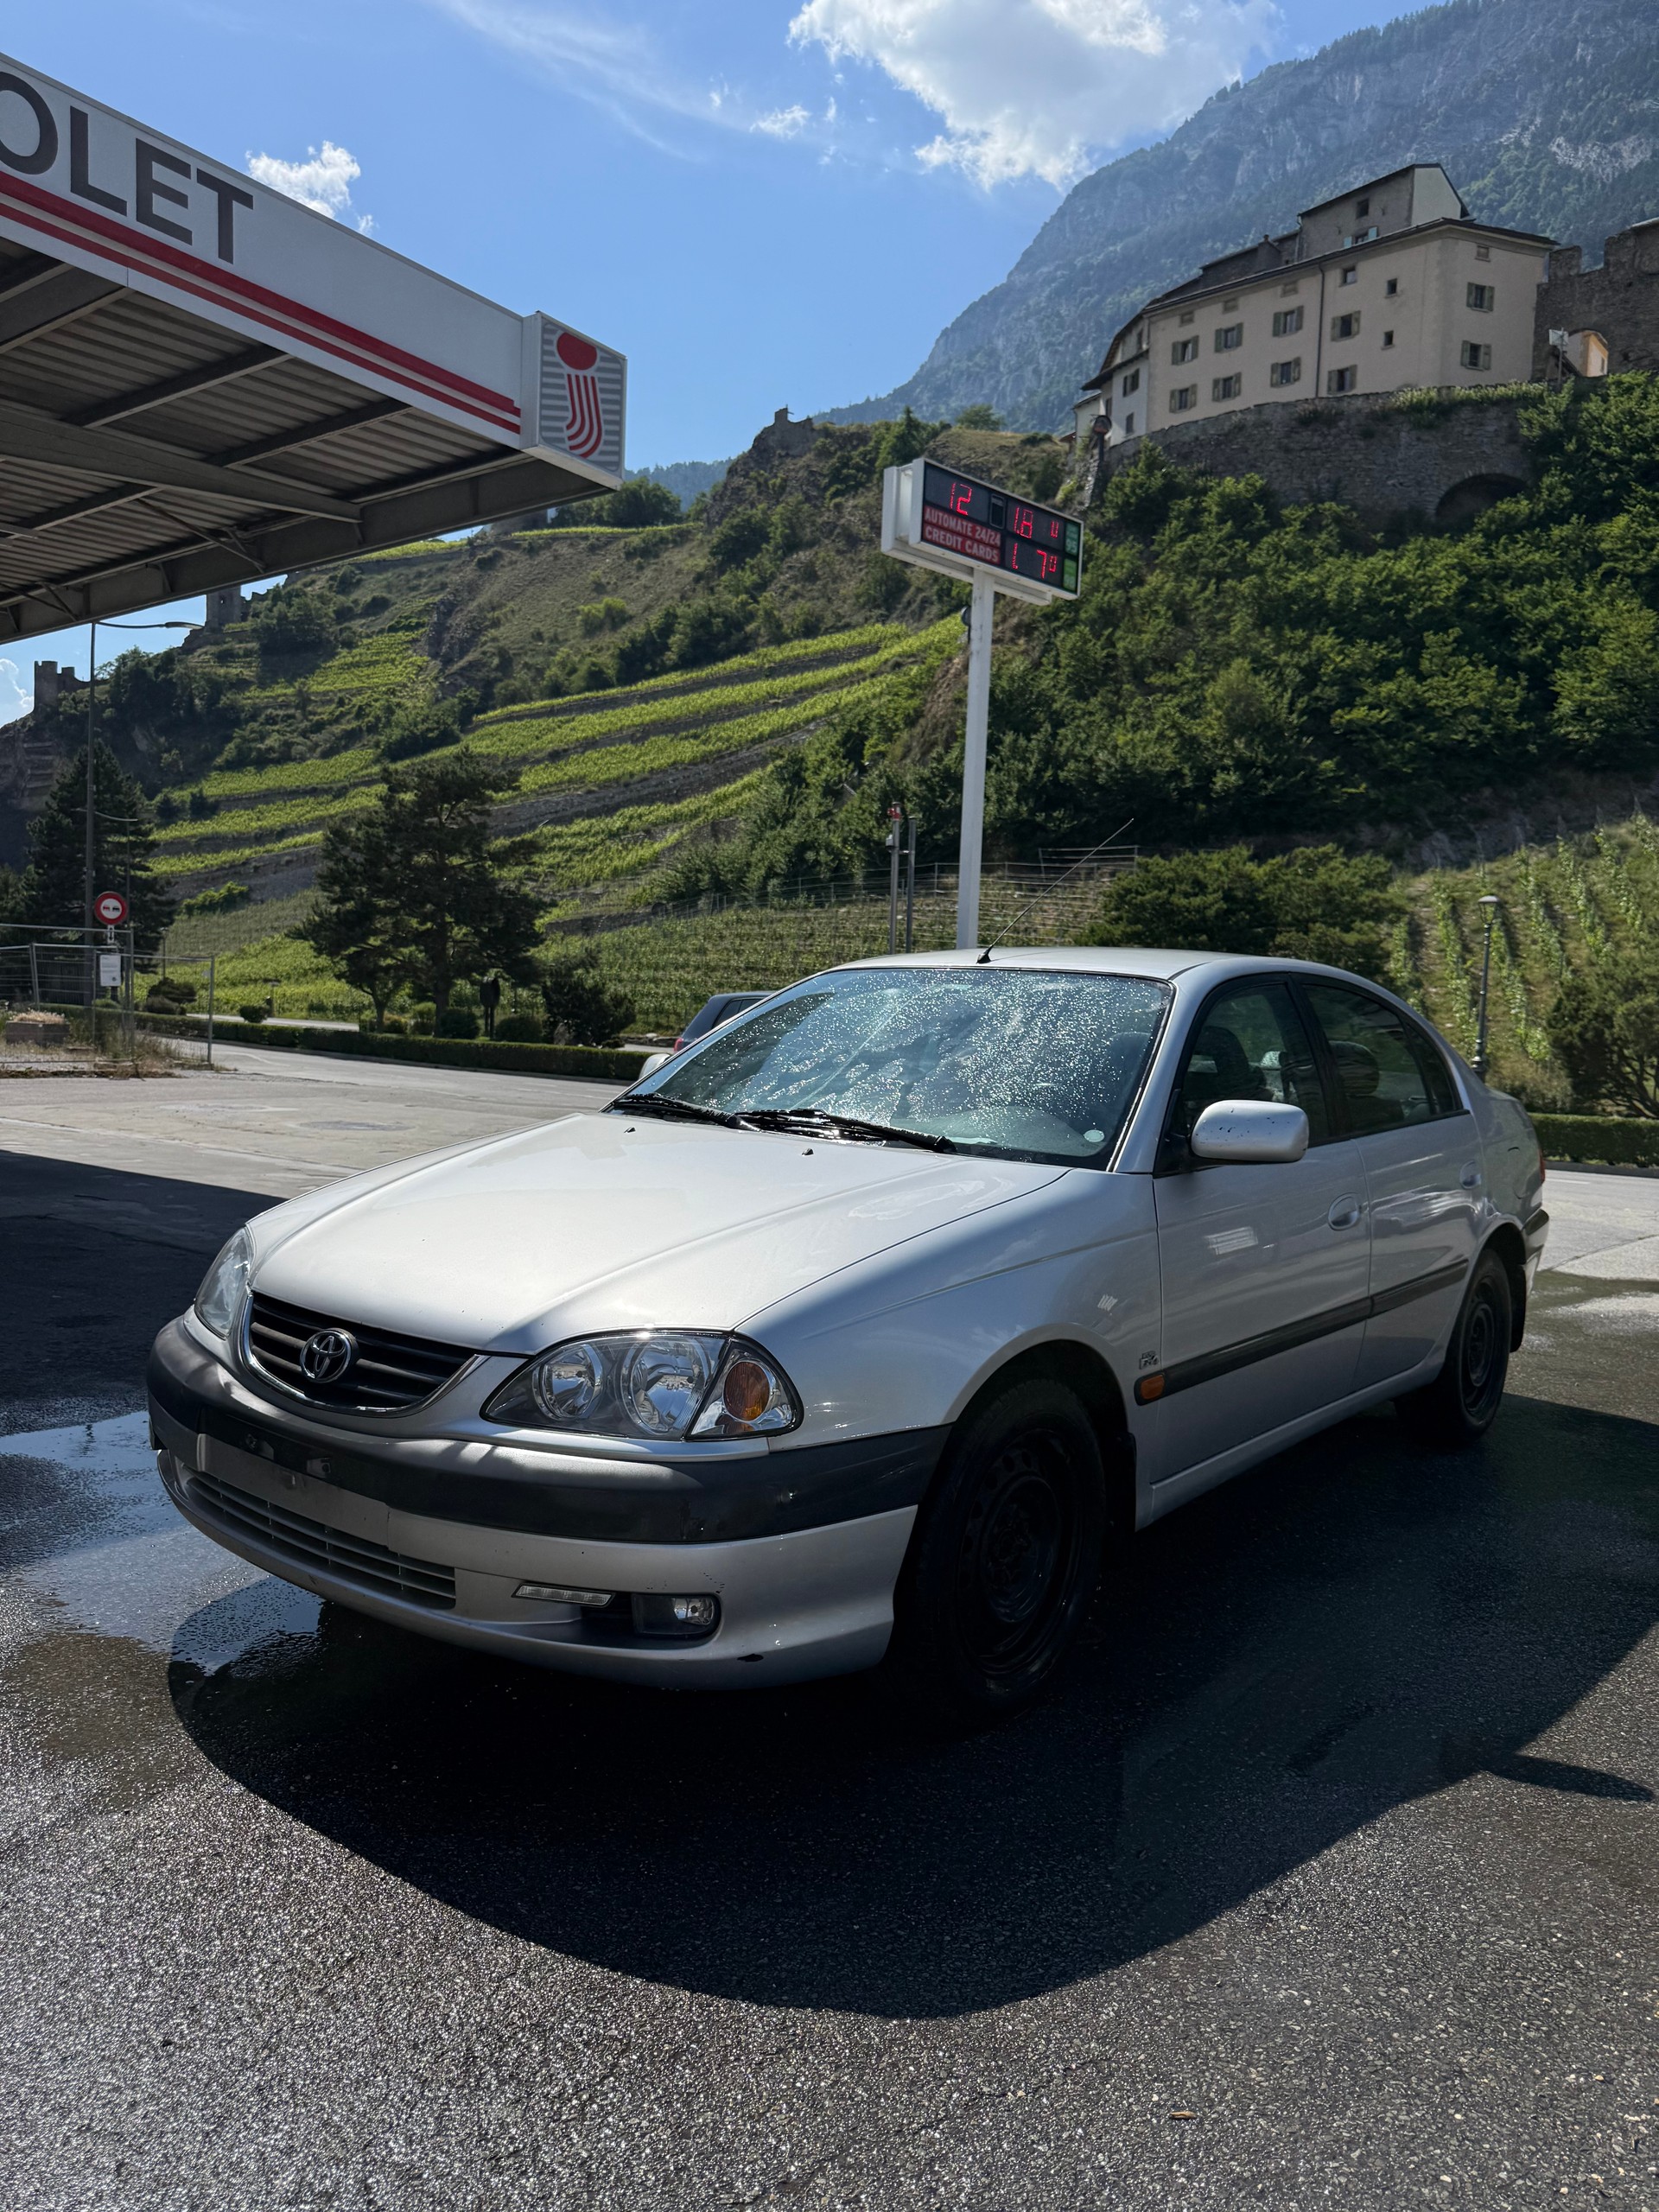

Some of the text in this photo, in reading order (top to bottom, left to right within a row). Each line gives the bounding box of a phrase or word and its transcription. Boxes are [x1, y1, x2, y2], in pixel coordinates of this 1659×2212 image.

[925, 507, 1001, 547] AUTOMATE 24/24
[925, 526, 998, 563] CREDIT CARDS
